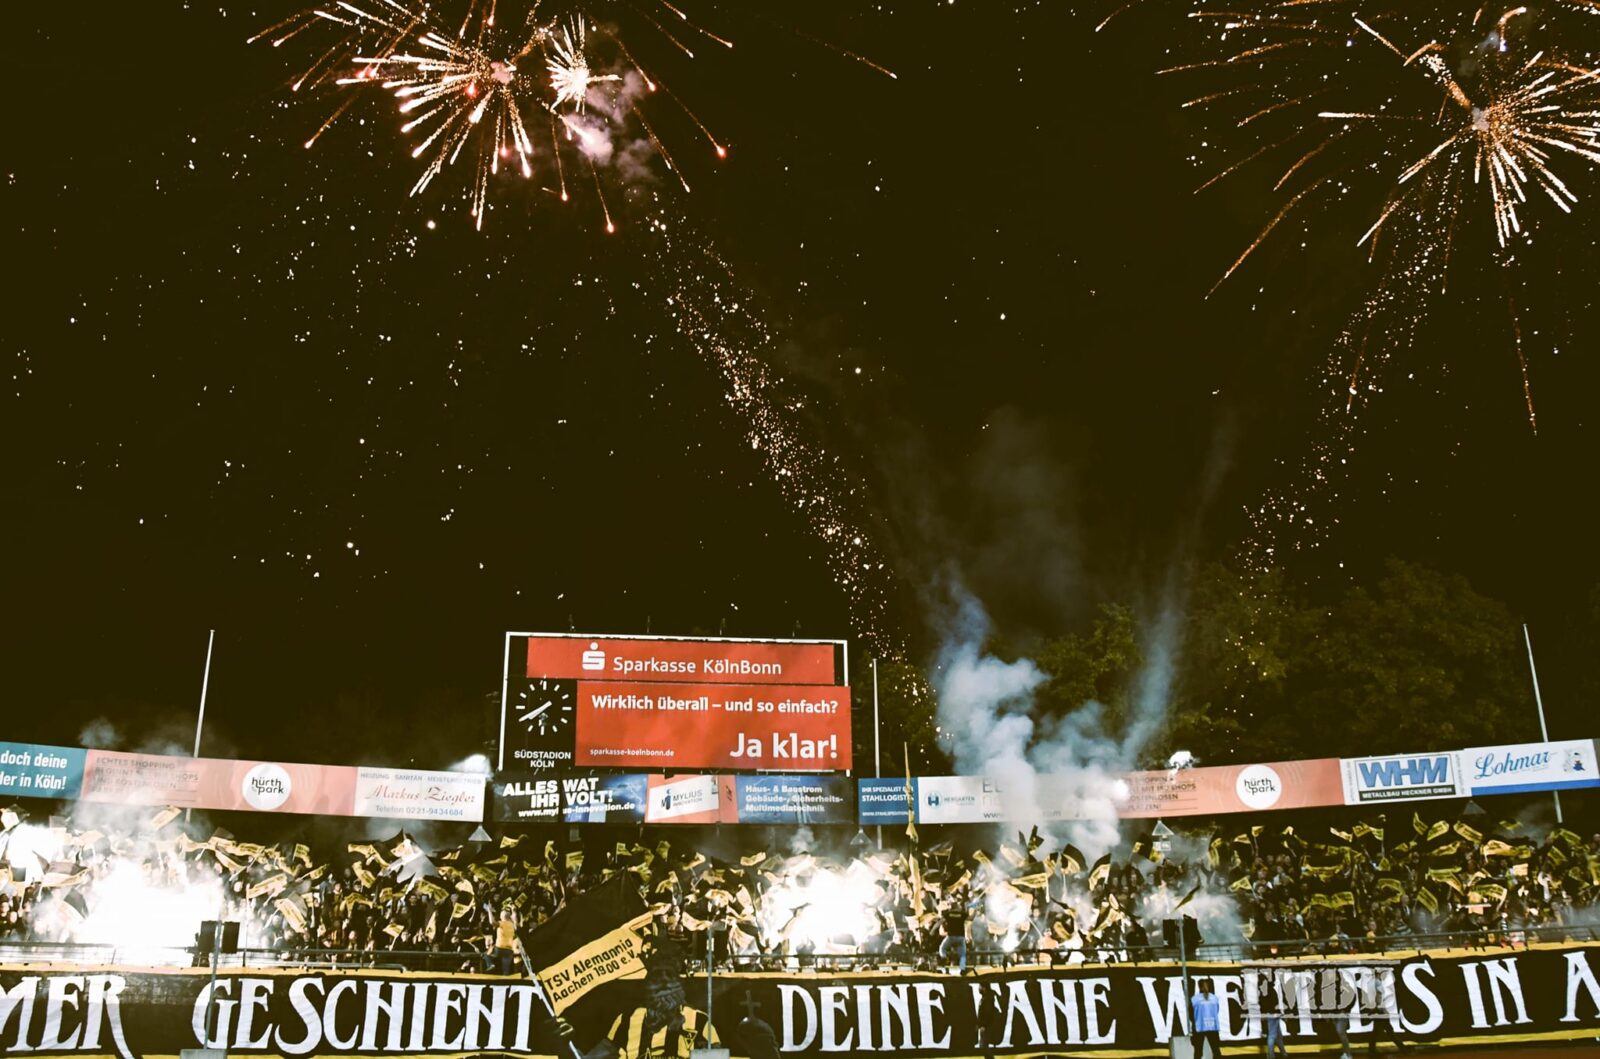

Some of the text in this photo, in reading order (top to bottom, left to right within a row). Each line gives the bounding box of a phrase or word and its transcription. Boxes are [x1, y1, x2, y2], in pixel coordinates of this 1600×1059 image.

[613, 656, 782, 675] Sparkasse KölnBonn
[591, 695, 654, 711] Wirklich
[658, 696, 709, 711] überall
[725, 698, 753, 712] und
[756, 701, 775, 712] so
[777, 699, 839, 713] einfach?
[513, 748, 572, 760] SÜDSTADION
[729, 732, 838, 759] Ja klar!
[0, 749, 68, 769] doch deine
[530, 758, 555, 768] KÖLN
[1474, 751, 1550, 780] Lohmar
[19, 772, 32, 788] in
[34, 773, 67, 790] Köln!
[1358, 757, 1449, 788] WHM
[252, 777, 282, 792] hürth
[257, 787, 284, 796] park
[502, 778, 599, 797] ALLES WAT
[745, 785, 771, 793] Haus-
[782, 785, 823, 793] Baustrom
[1244, 776, 1272, 791] hürth
[1250, 785, 1276, 796] park
[365, 784, 420, 801] Markus
[531, 790, 613, 808] IHR VOLT!
[673, 789, 703, 801] MYLIUS
[1362, 790, 1401, 799] METALLBAU
[1401, 787, 1432, 796] HECKNER
[518, 802, 636, 818] www.mylus-innovation.de
[745, 804, 825, 813] Multimediatechnik
[544, 938, 633, 991] TSV Alemannia
[552, 974, 594, 1003] Aachen
[593, 960, 621, 977] 1900
[778, 983, 951, 1052] DEINE
[1458, 957, 1533, 1029] IN
